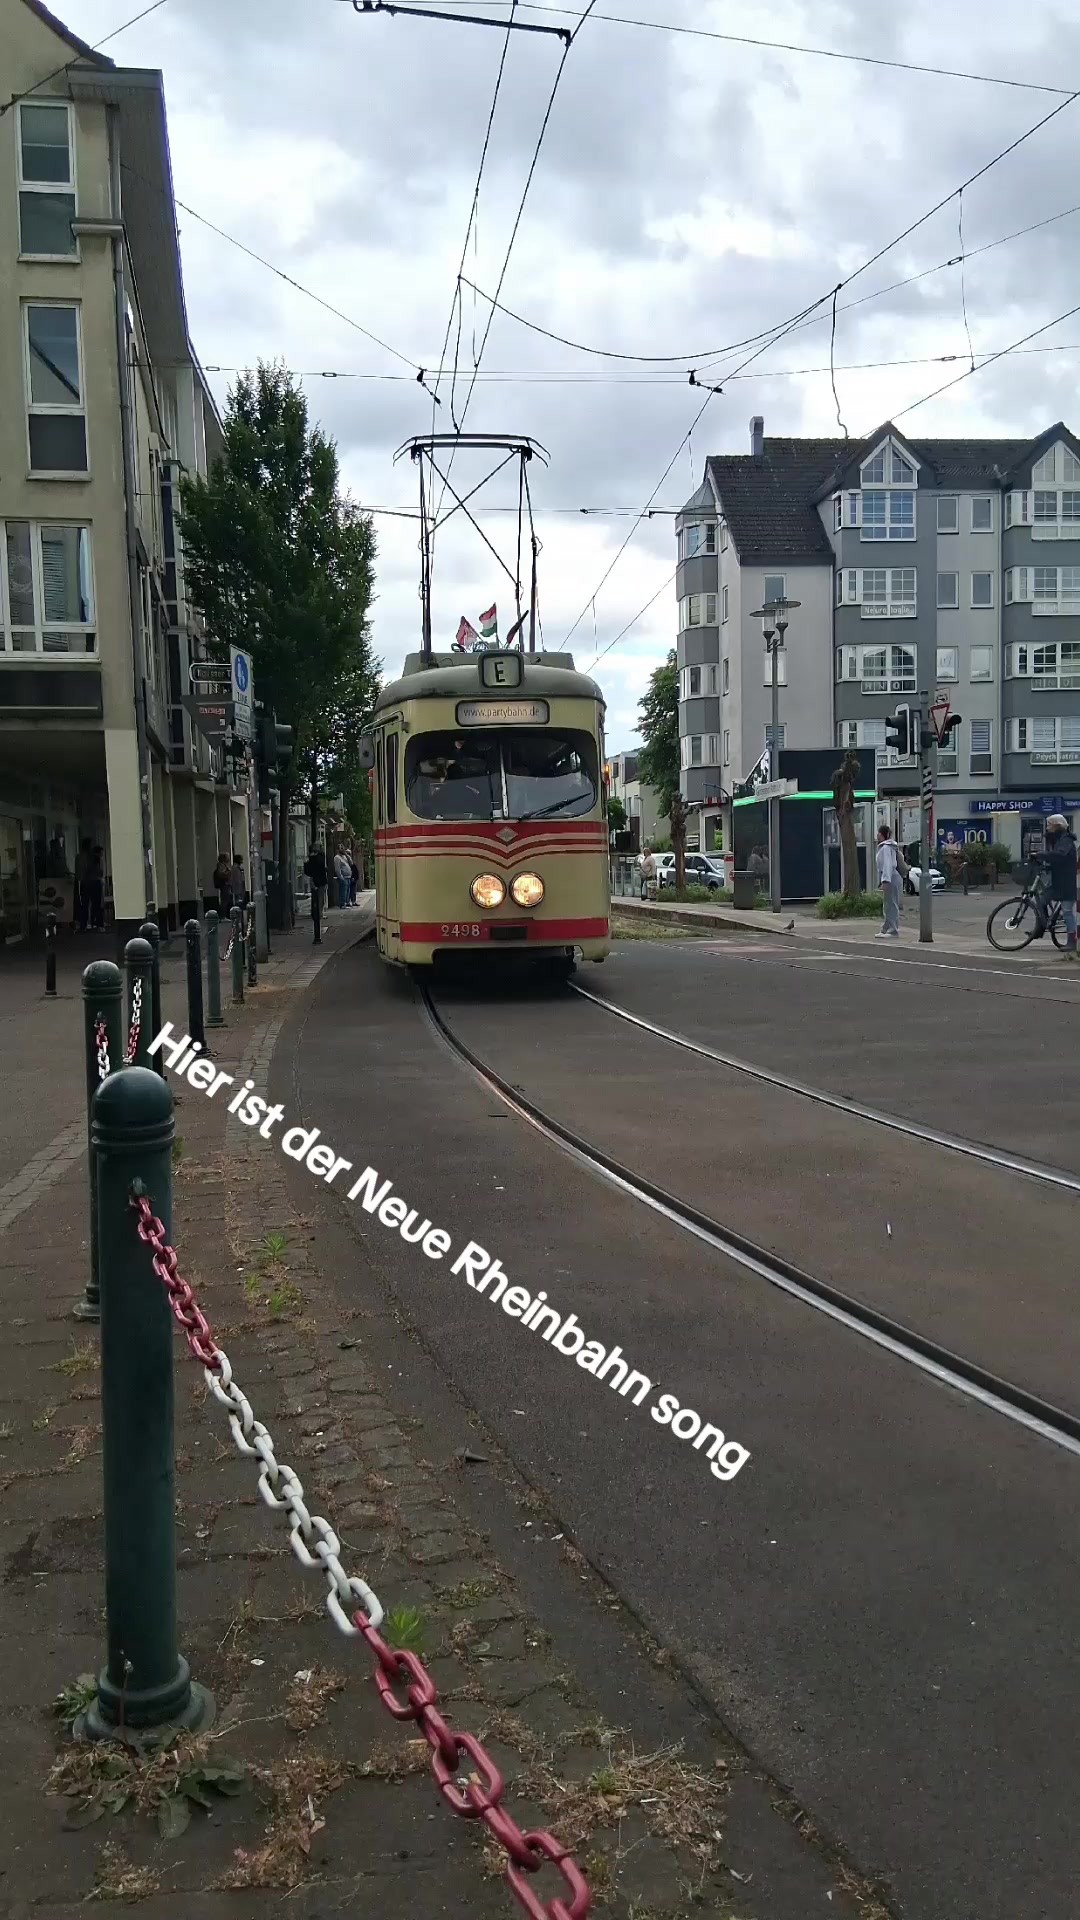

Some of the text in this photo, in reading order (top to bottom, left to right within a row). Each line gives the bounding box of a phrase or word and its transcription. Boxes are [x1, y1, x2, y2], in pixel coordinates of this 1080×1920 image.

[494, 661, 506, 682] E
[463, 706, 539, 718] www.partybahn.de
[978, 801, 1008, 810] HAPPY
[1009, 801, 1034, 810] SHOP
[964, 829, 987, 844] 100
[441, 924, 480, 937] 2498
